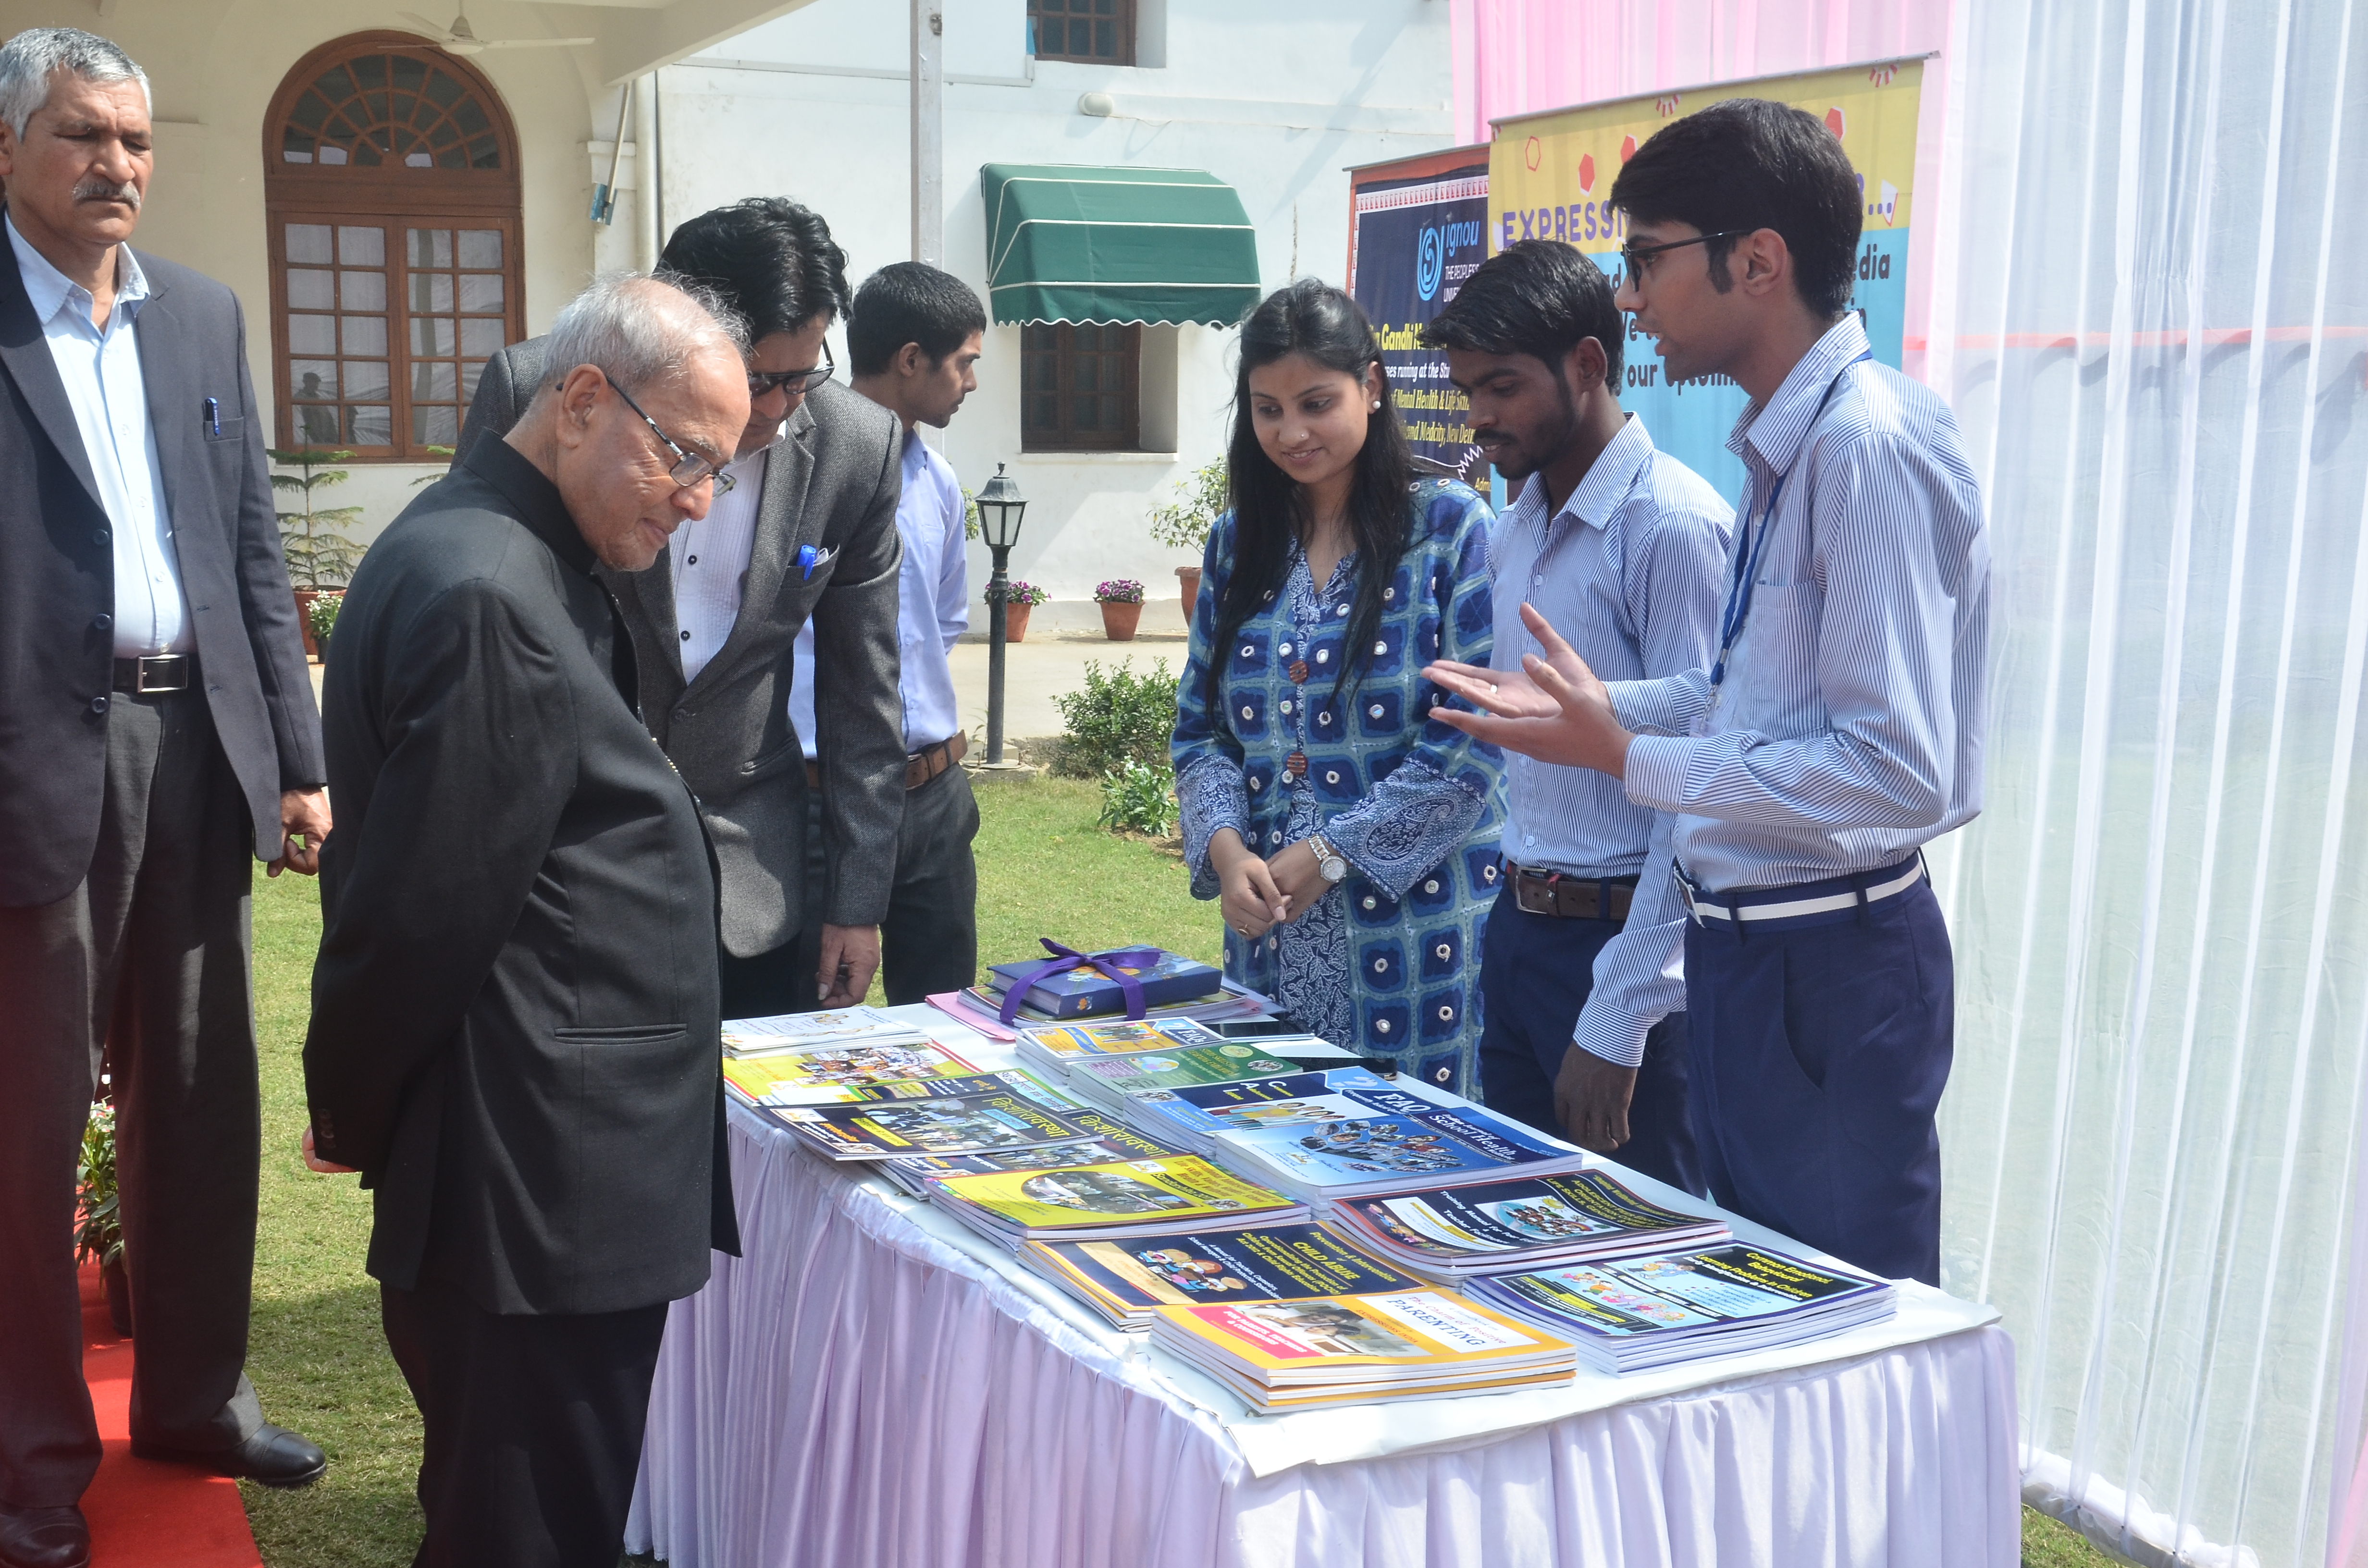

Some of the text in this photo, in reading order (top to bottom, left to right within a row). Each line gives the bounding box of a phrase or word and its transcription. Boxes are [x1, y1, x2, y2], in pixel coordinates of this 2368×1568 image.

[1503, 199, 1622, 248] EXPRESSI
[1446, 221, 1480, 257] ignou
[1445, 266, 1454, 280] THE
[1853, 244, 1890, 281] dia
[1443, 287, 1461, 302] UNIVE
[1381, 323, 1414, 350] Gandhi
[1397, 362, 1418, 382] running
[1418, 363, 1427, 378] at
[1428, 362, 1439, 378] the
[1627, 364, 1657, 388] our
[1398, 389, 1416, 408] Mental
[1415, 390, 1438, 409] Health
[1439, 390, 1444, 409] &
[1445, 390, 1456, 416] Life
[1419, 421, 1446, 448] Medcity,
[1446, 423, 1459, 442] New
[1178, 1029, 1207, 1042] FAQs
[984, 1098, 1069, 1137] किशोरावस्था
[1073, 1115, 1169, 1156] किशोरावस्था
[1429, 1115, 1477, 1135] School
[1471, 1135, 1516, 1155] Health
[1546, 1178, 1564, 1188] LIFE
[1571, 1180, 1616, 1208] ADOLESCENT
[1441, 1191, 1466, 1210] Training
[1465, 1210, 1492, 1225] Manual
[1574, 1189, 1619, 1215] ORIENTATION
[1444, 1210, 1470, 1228] Teacher
[1242, 1233, 1265, 1247] Children
[1262, 1247, 1278, 1255] from
[1274, 1255, 1296, 1266] Sexual
[1291, 1242, 1362, 1279] CHILD ABUSE
[1310, 1232, 1347, 1255] Prevention
[1352, 1259, 1396, 1282] Intervention
[1683, 1256, 1707, 1265] Early
[1746, 1253, 1786, 1269] Common
[1262, 1255, 1280, 1264] Child
[1292, 1275, 1320, 1292] Education
[1310, 1269, 1339, 1286] Protection
[1695, 1254, 1732, 1269] Learning
[1729, 1268, 1768, 1283] Problems
[1776, 1285, 1812, 1297] Children
[1748, 1262, 1803, 1282] Behavioural
[1223, 1311, 1241, 1319] FOR
[1388, 1300, 1485, 1345] PARENTING
[1408, 1296, 1425, 1305] The
[1426, 1306, 1455, 1320] Charm
[1469, 1327, 1506, 1343] Positive
